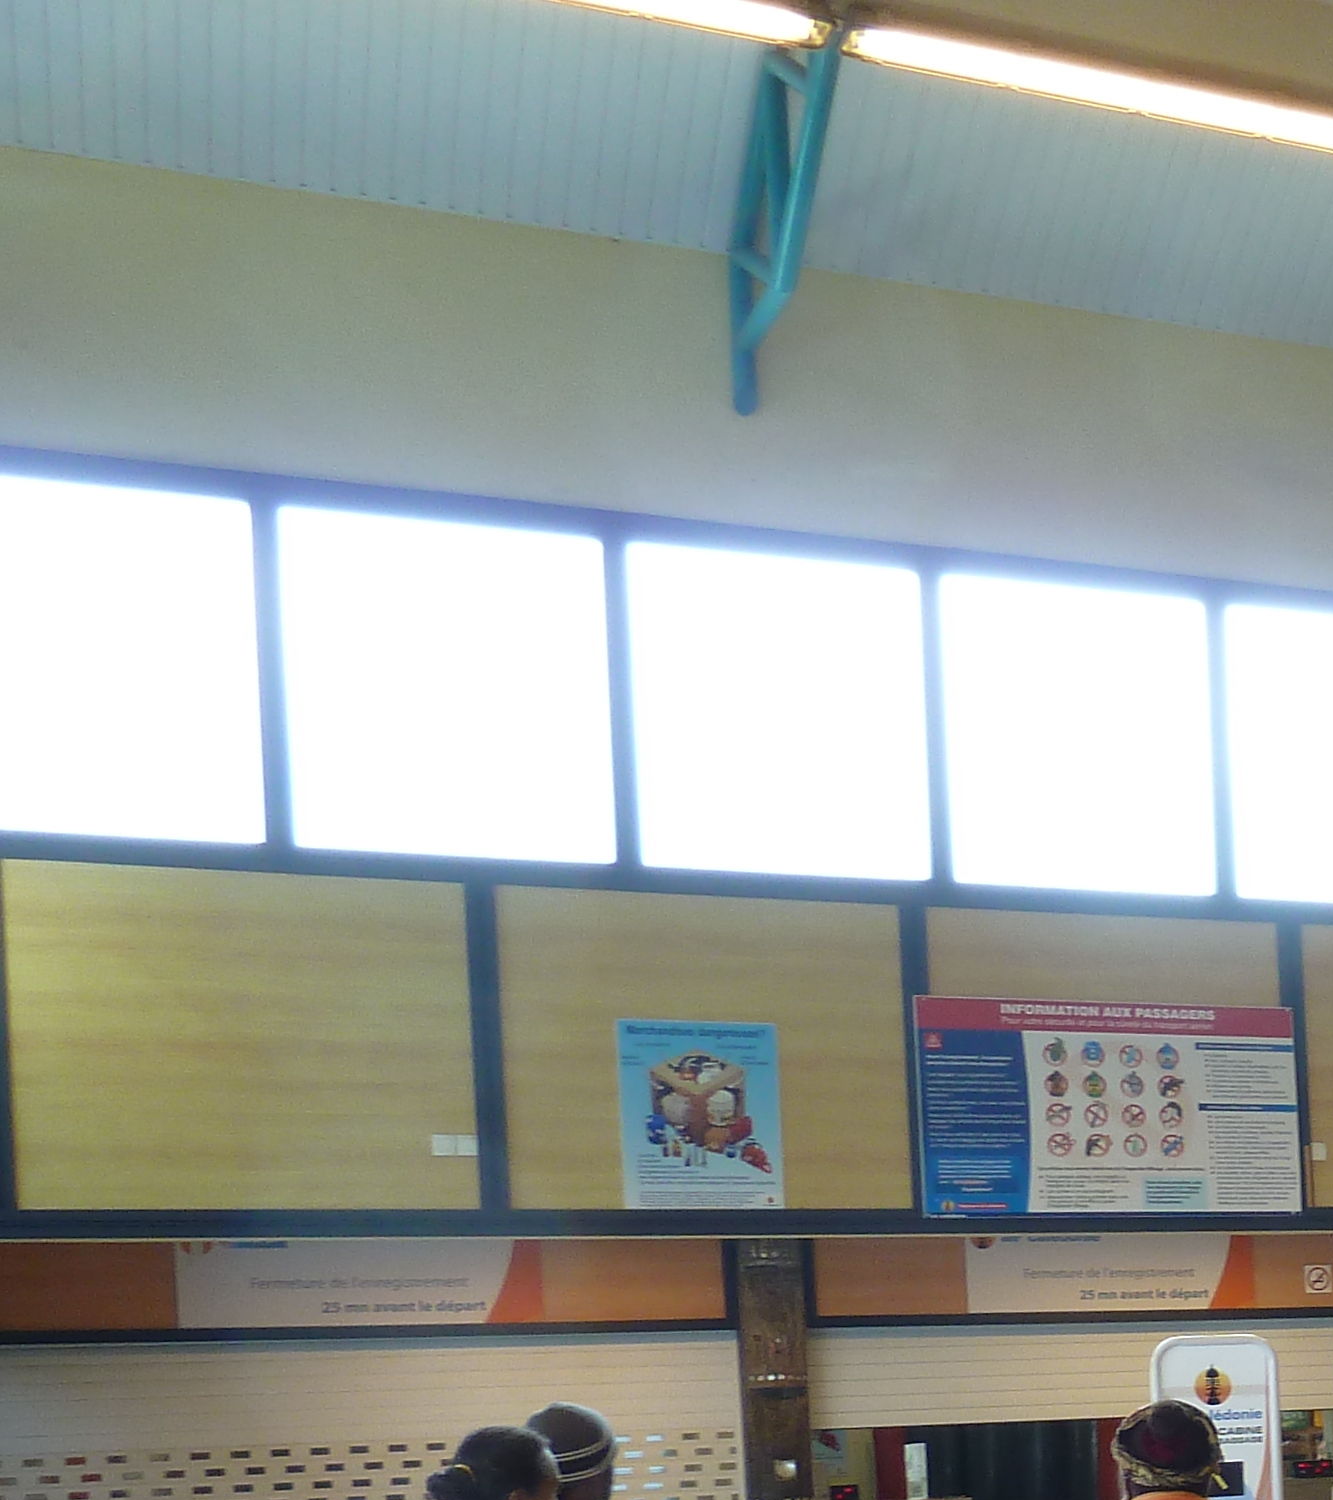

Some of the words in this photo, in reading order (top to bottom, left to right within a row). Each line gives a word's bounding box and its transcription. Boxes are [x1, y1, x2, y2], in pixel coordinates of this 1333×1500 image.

[1000, 1003, 1099, 1017] INFORMATION
[1103, 1007, 1132, 1018] AUX
[1135, 1008, 1216, 1020] PASSAGERS
[1080, 1290, 1095, 1300] 25
[1120, 1291, 1153, 1299] avant
[1156, 1289, 1167, 1299] le
[1169, 1288, 1209, 1300] départ
[322, 1302, 340, 1313] 25
[373, 1303, 415, 1313] avant
[418, 1301, 432, 1312] le
[435, 1300, 487, 1314] départ
